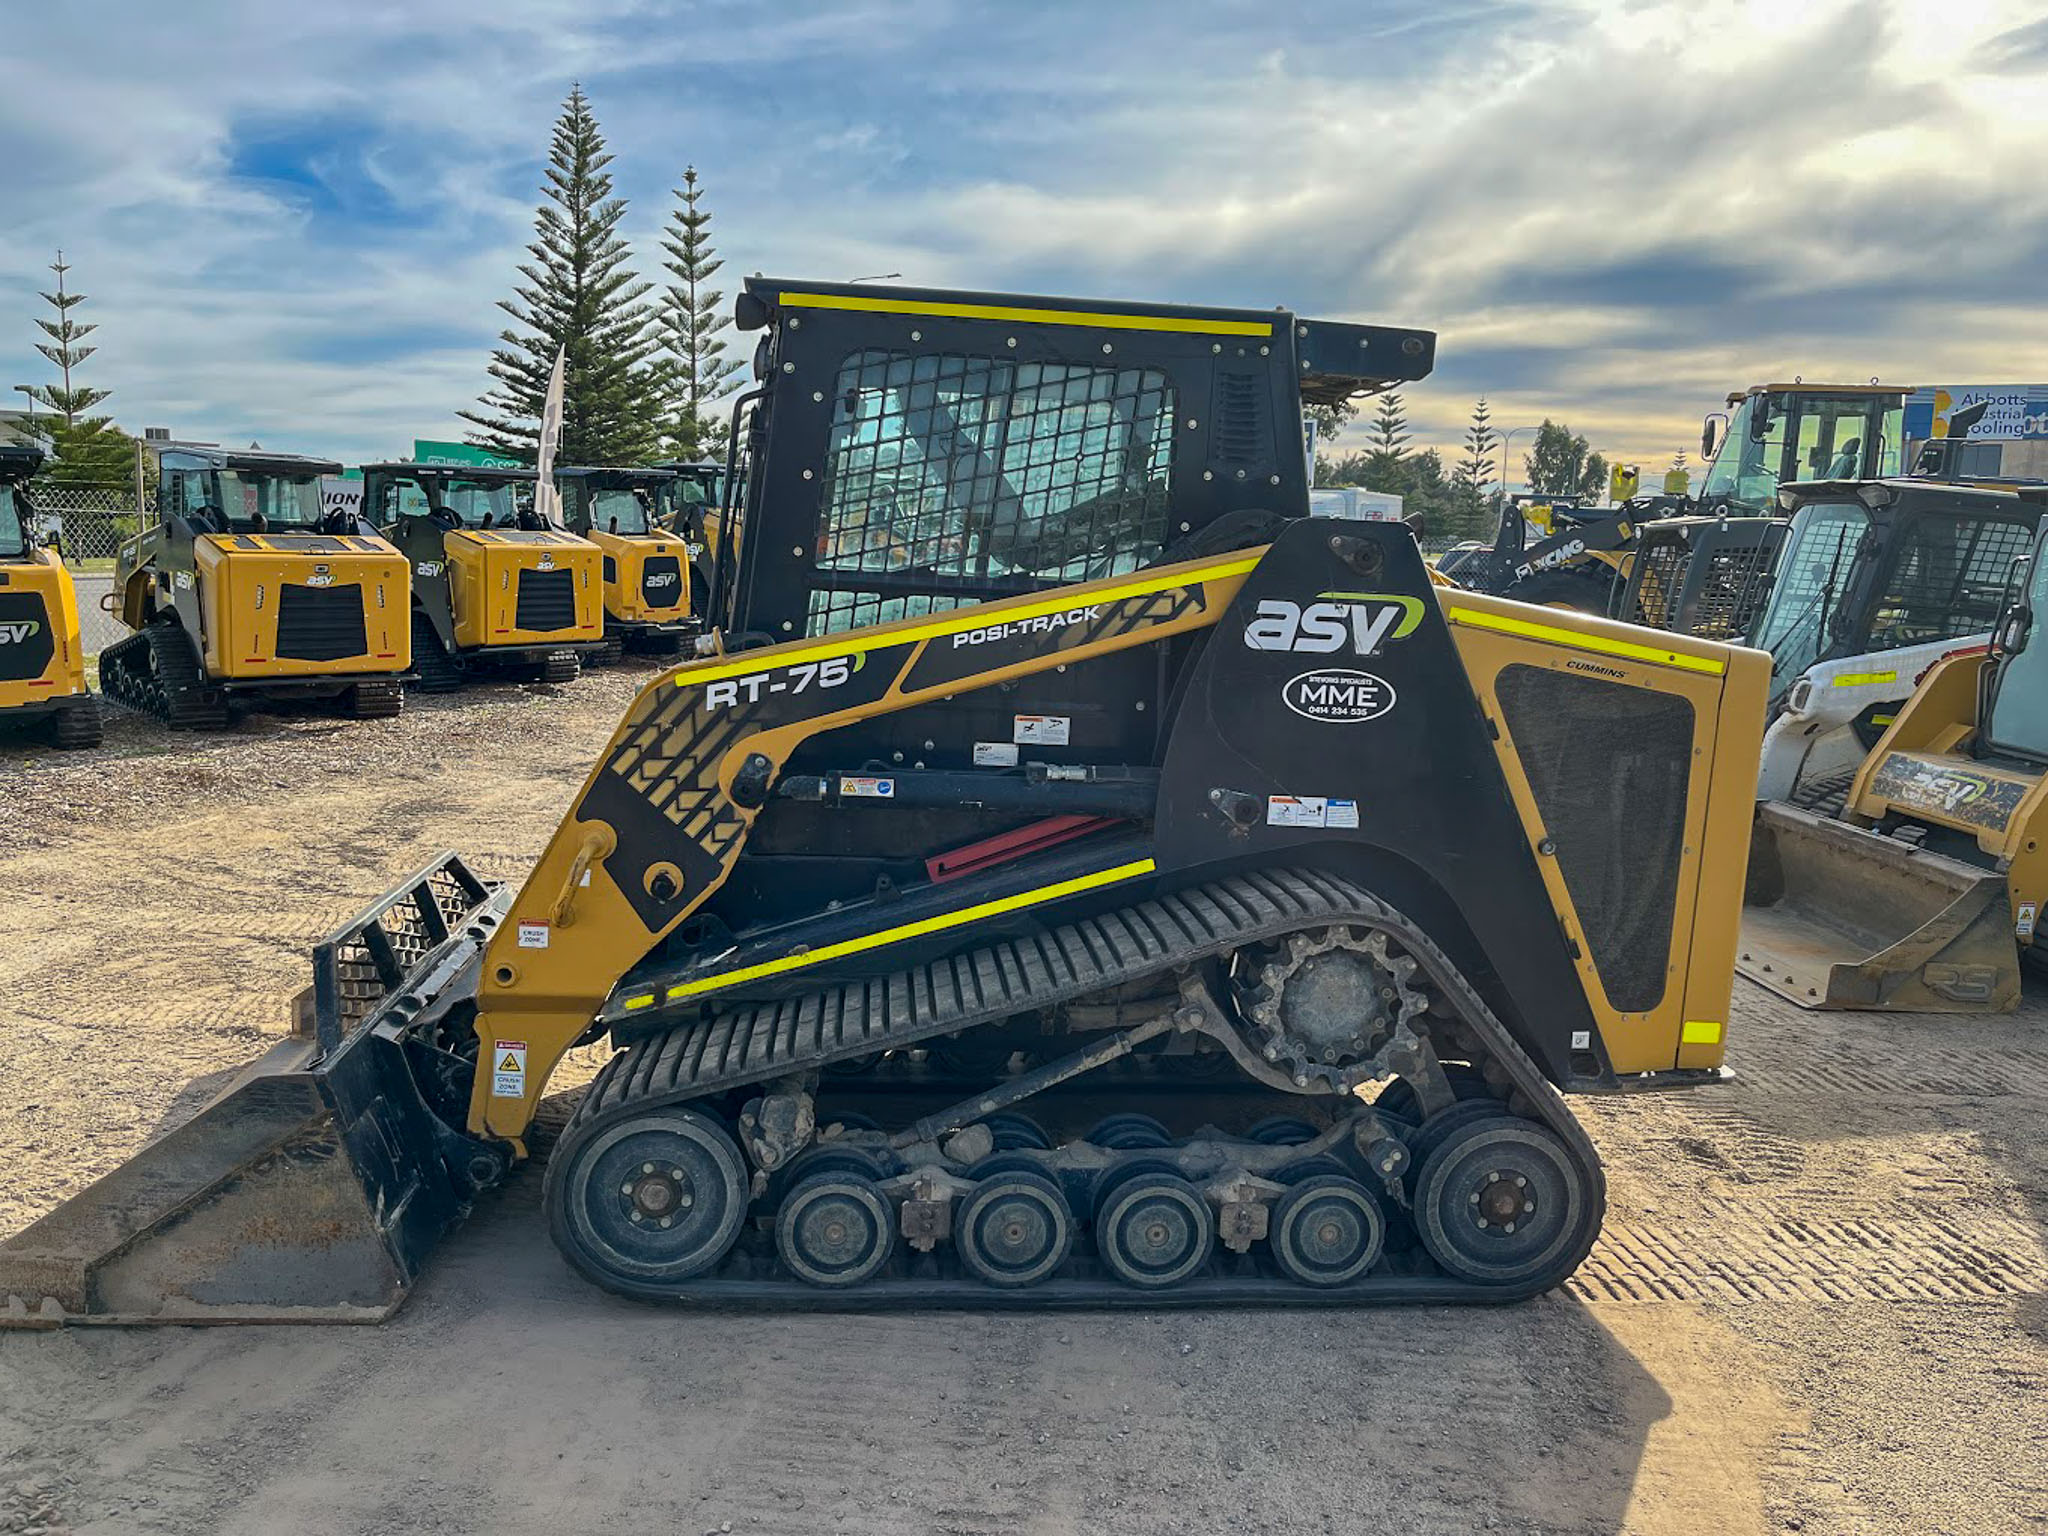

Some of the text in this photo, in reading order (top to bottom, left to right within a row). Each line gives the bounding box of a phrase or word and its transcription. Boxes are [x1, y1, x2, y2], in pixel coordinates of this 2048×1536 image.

[1962, 392, 2027, 406] Abbotts
[1969, 421, 2025, 437] ooling
[325, 492, 360, 505] ION
[646, 573, 676, 588] asv
[0, 622, 36, 645] sv
[953, 605, 1100, 649] POSI-TRACK
[1567, 661, 1626, 678] CUMMINS
[706, 657, 850, 712] RT-75
[1300, 684, 1378, 707] MME
[1308, 706, 1368, 716] 0414 234 535
